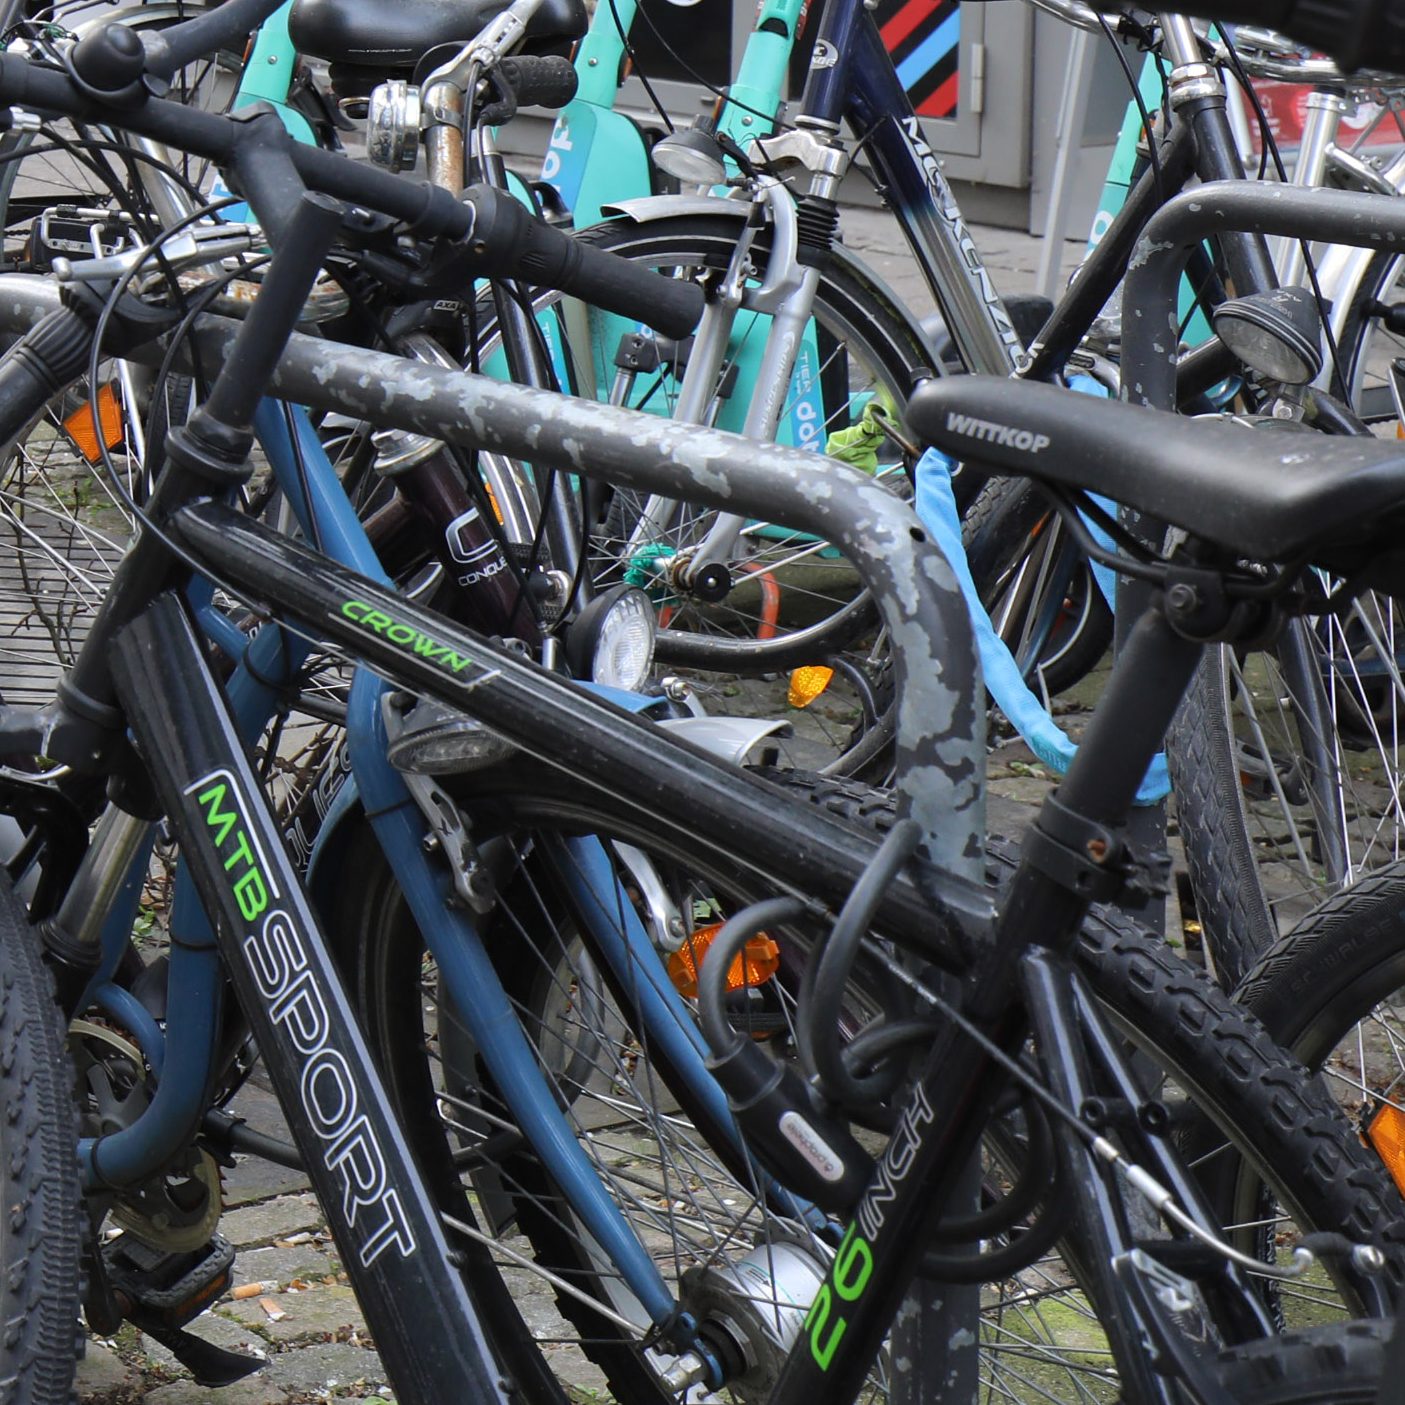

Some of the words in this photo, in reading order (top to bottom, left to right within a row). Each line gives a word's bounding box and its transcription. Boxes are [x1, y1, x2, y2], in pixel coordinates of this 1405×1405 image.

[436, 301, 457, 311] AXA
[946, 411, 1050, 456] WITTKOP
[457, 555, 508, 587] CONQUE
[340, 601, 474, 674] CROWN
[196, 783, 270, 923] MTB
[242, 909, 418, 1268] SPORT
[804, 1219, 874, 1372] 26
[860, 1081, 935, 1242] INCH
